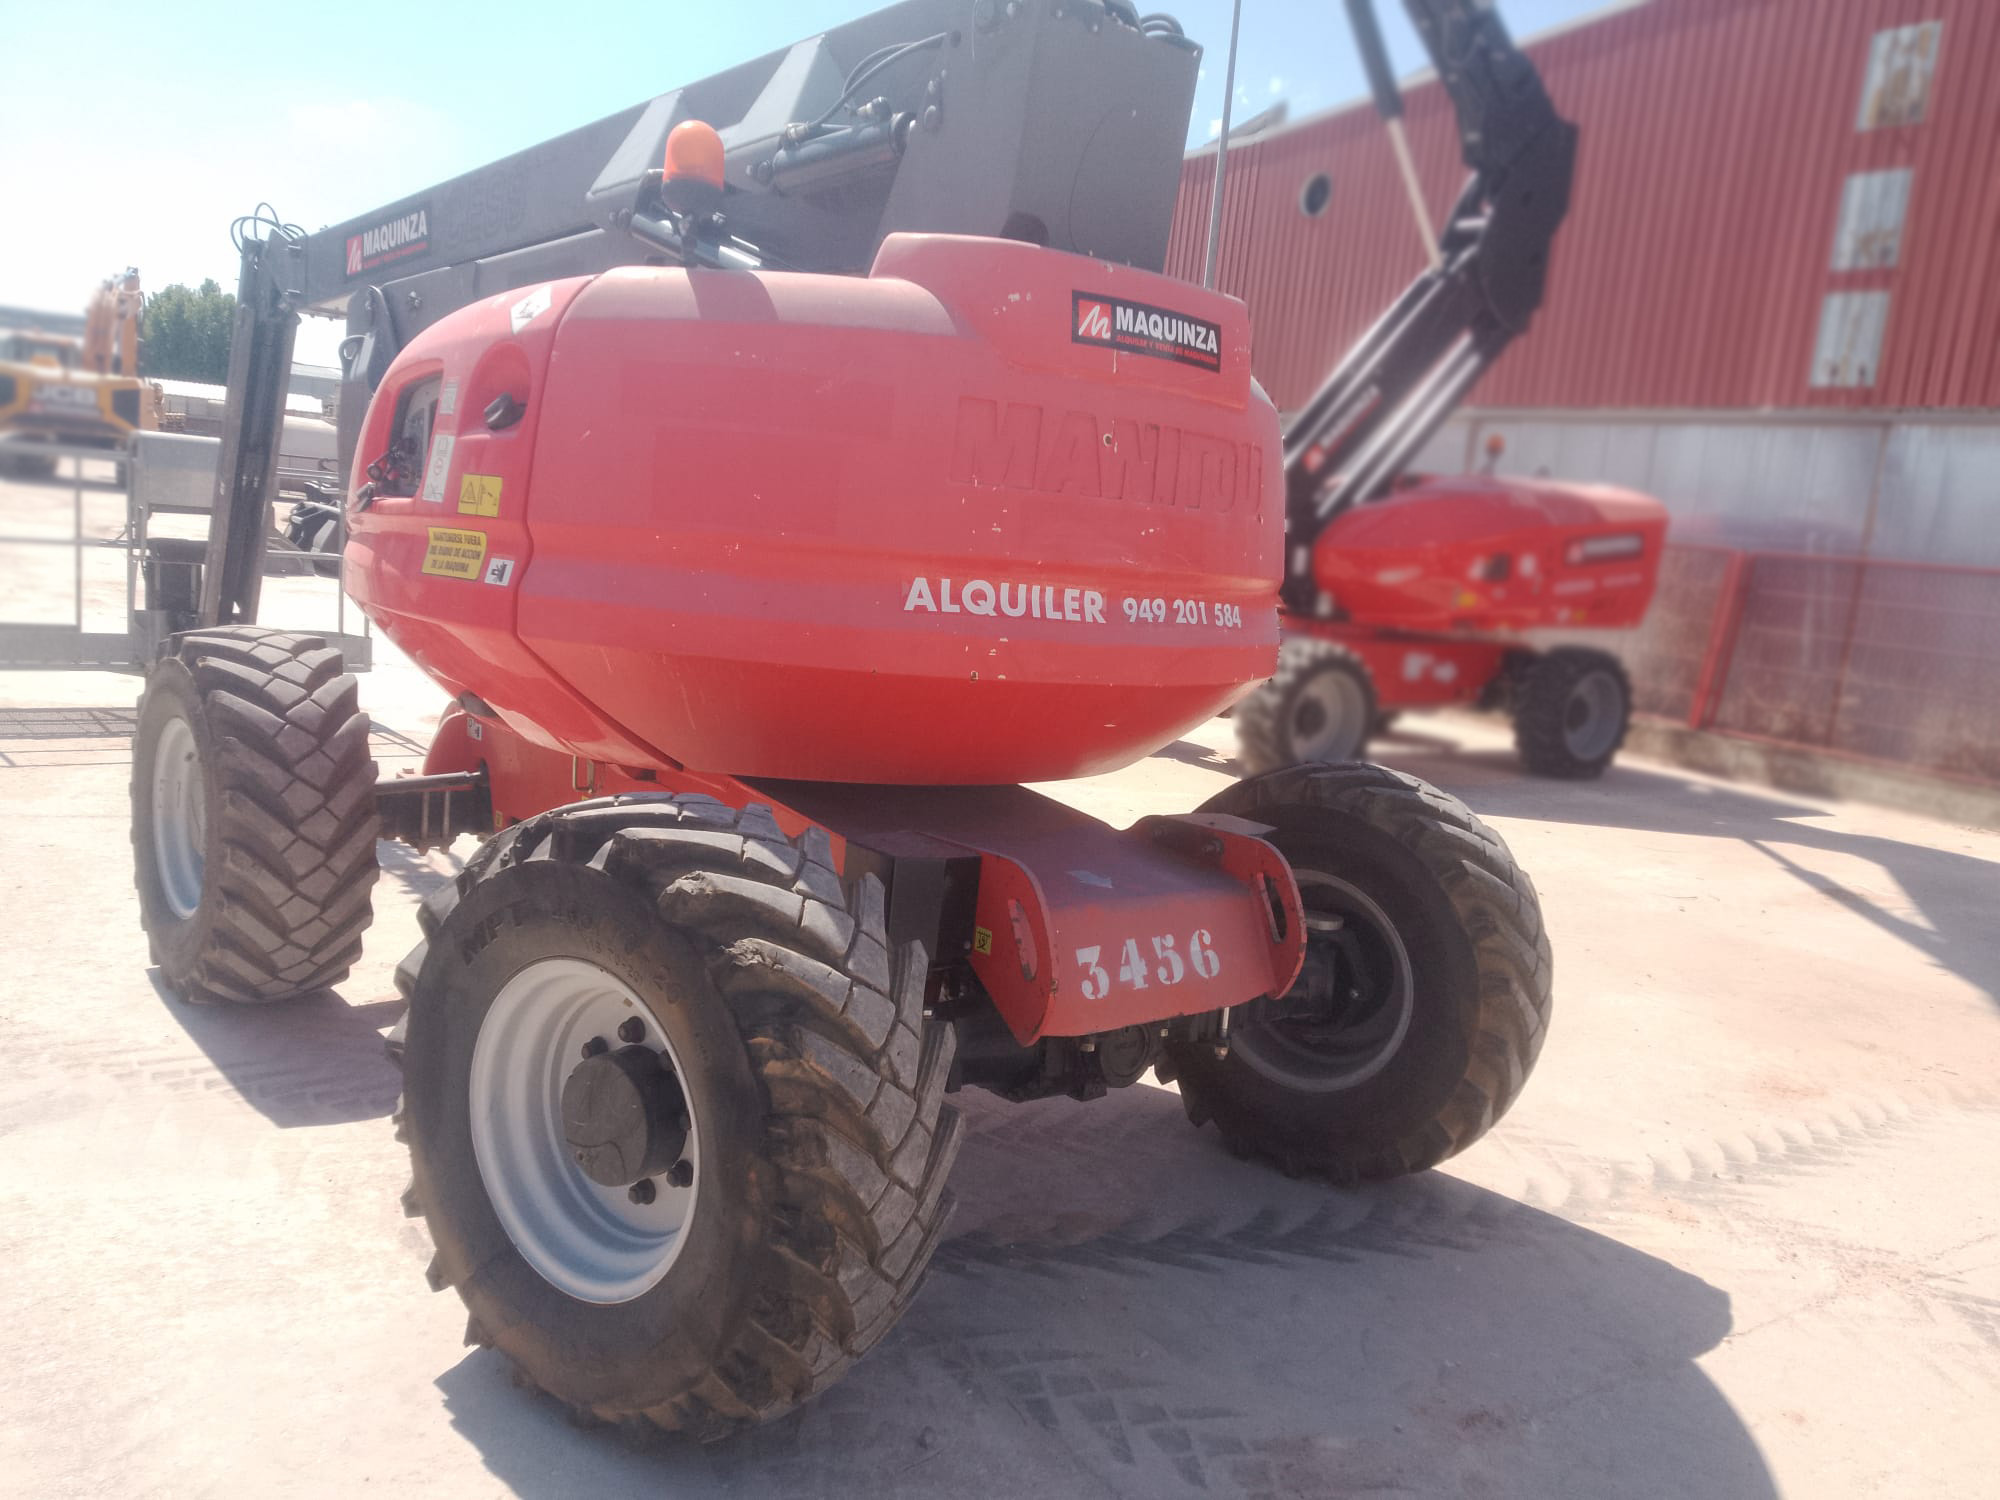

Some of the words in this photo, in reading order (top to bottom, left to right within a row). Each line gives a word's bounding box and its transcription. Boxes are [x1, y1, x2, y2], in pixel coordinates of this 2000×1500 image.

[363, 210, 428, 256] MAQUINZA
[1116, 305, 1218, 354] MAQUINZA
[904, 577, 1106, 623] ALQUILER
[1123, 597, 1166, 623] 949
[1173, 599, 1207, 625] 201
[1215, 603, 1242, 628] 584
[1076, 929, 1220, 1000] 3456
